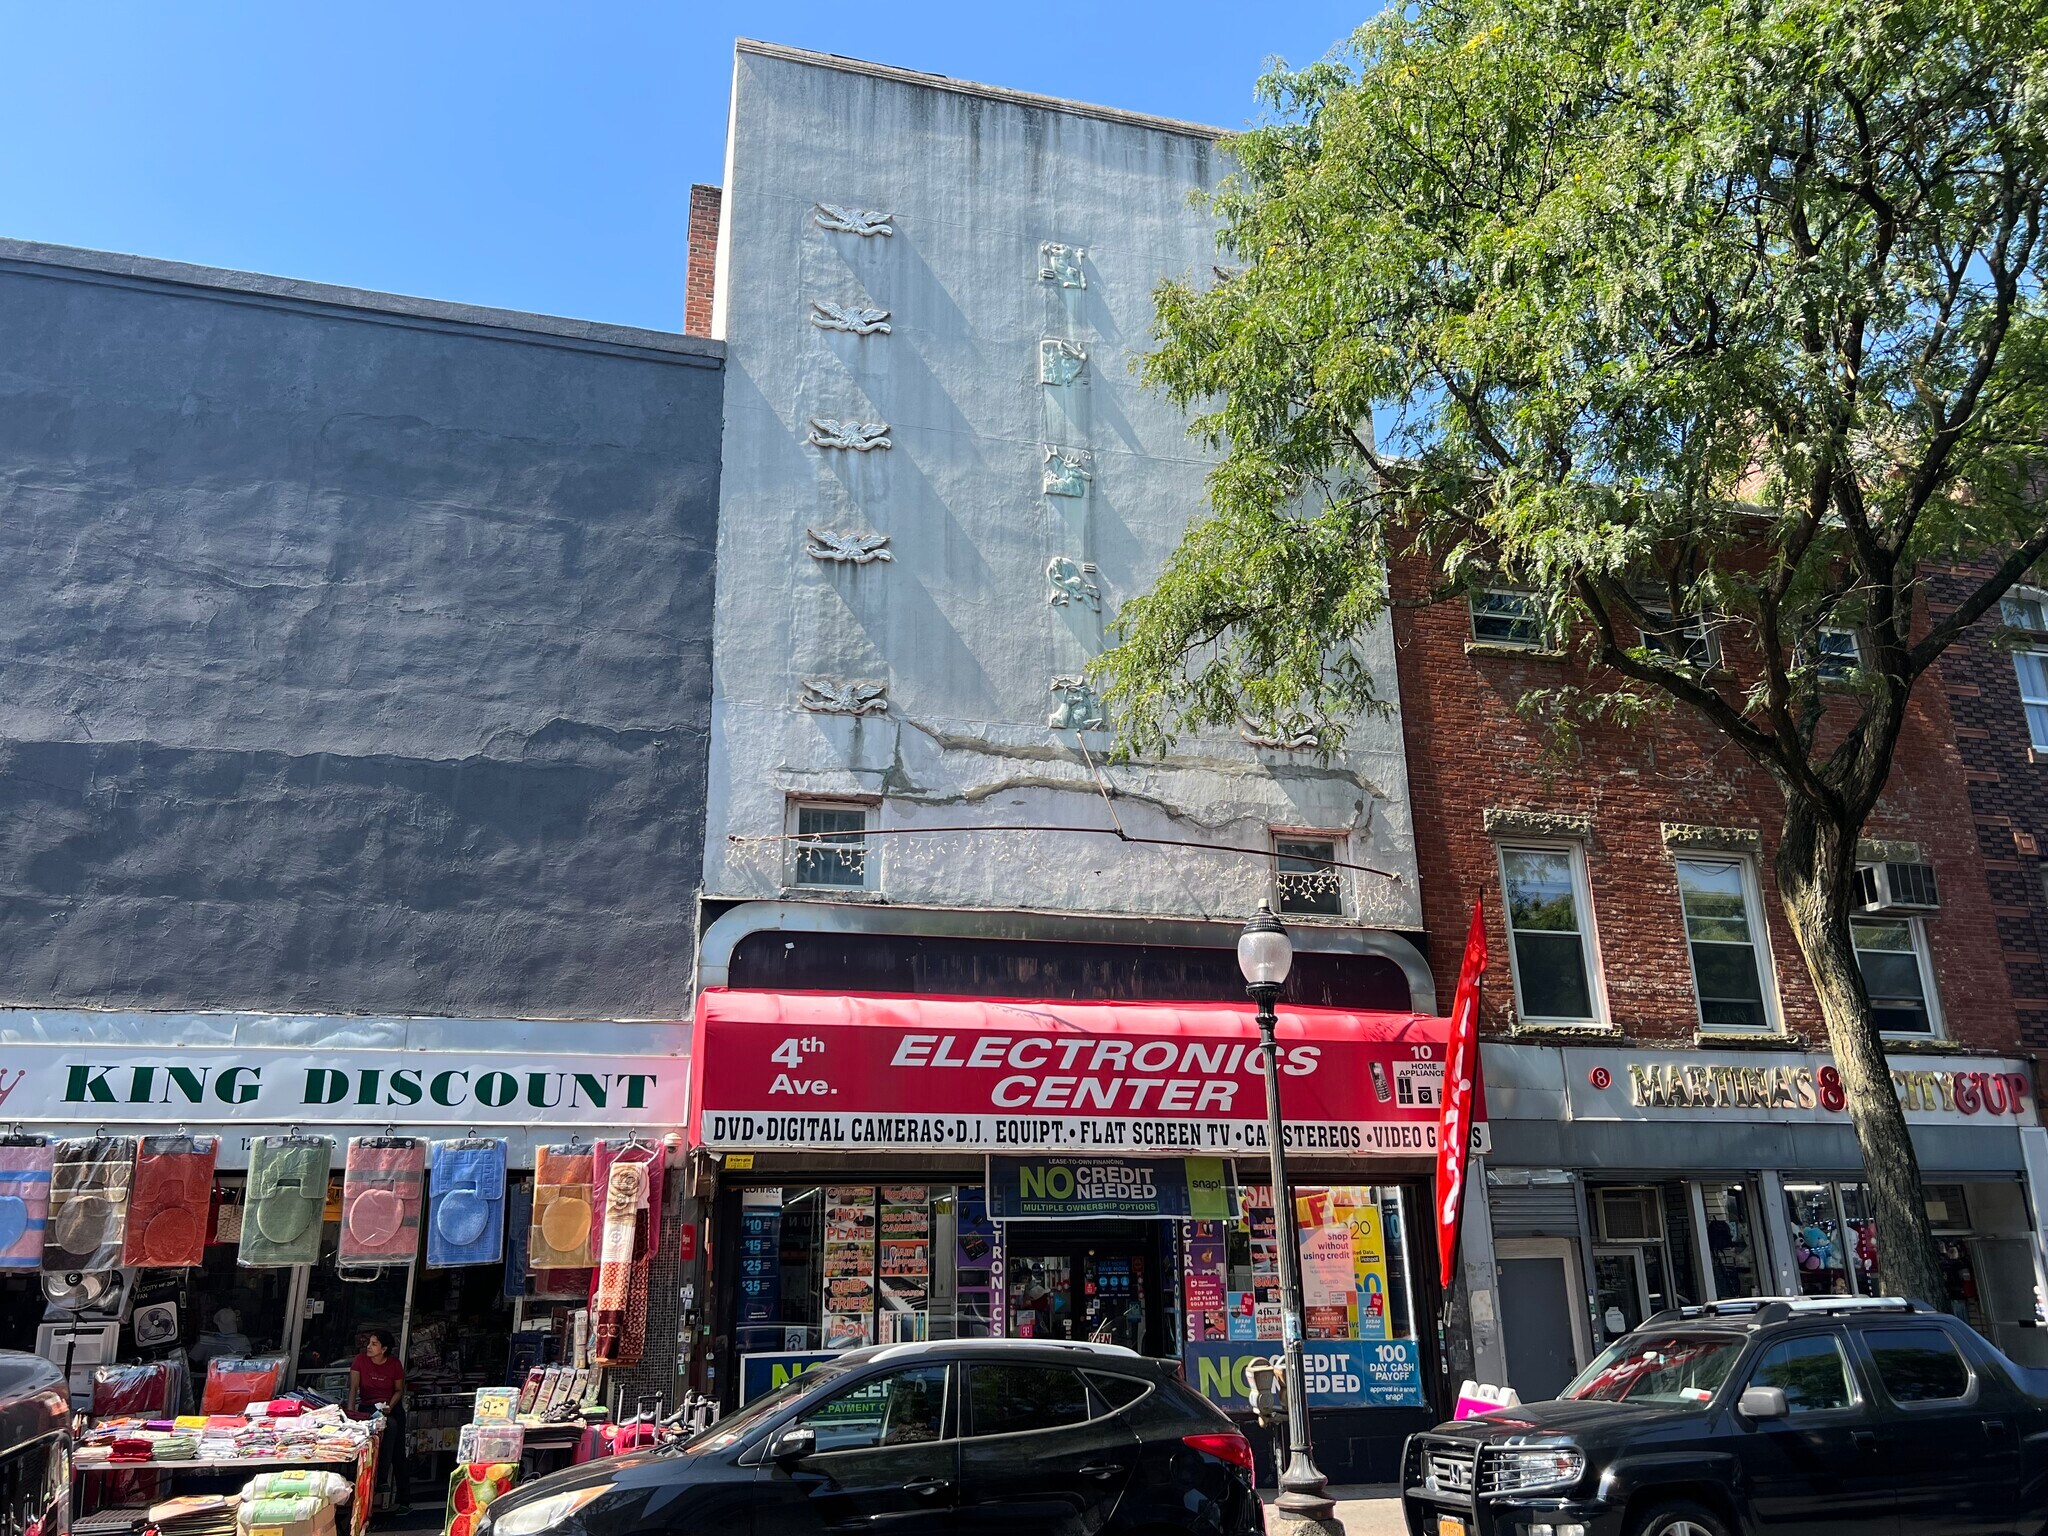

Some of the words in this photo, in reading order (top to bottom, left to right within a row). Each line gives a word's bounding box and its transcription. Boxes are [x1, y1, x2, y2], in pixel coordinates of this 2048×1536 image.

[771, 1036, 825, 1069] 4th
[890, 1034, 1321, 1076] ELECTRONICS
[1410, 1045, 1433, 1060] 10
[60, 1064, 264, 1106] KING
[299, 1067, 657, 1110] DISCOUNT
[768, 1073, 838, 1096] Ave.
[990, 1075, 1239, 1112] CENTER
[714, 1116, 755, 1141] DVD
[766, 1117, 845, 1142] DIGITAL
[851, 1118, 945, 1143] CAMERAS
[956, 1120, 988, 1144] D.J.
[996, 1120, 1068, 1146] EQUIPT.
[1080, 1121, 1127, 1145] FLAT
[1133, 1121, 1201, 1146] SCREEN
[1207, 1123, 1231, 1146] TV
[1245, 1123, 1271, 1147] CA
[1283, 1124, 1361, 1148] STEREOS
[1372, 1126, 1421, 1148] VIDEO
[1076, 1166, 1154, 1184] CREDIT
[1019, 1166, 1075, 1199] NO
[1192, 1179, 1221, 1192] snap!
[884, 1189, 925, 1200] REPAIRS
[1076, 1183, 1157, 1200] NEEDED
[1066, 1203, 1117, 1211] OWNERSHIP
[1119, 1202, 1156, 1211] OPTIONS
[835, 1208, 866, 1222] HOT
[826, 1227, 874, 1240] PLATE
[1327, 1233, 1348, 1242] Shop
[1317, 1242, 1349, 1250] without
[1303, 1252, 1325, 1261] using
[1326, 1251, 1350, 1259] credit
[831, 1280, 868, 1293] DEEP
[829, 1297, 869, 1310] FRIER
[830, 1323, 868, 1337] IRON
[1374, 1344, 1407, 1362] 100
[1369, 1363, 1387, 1372] DAY
[1389, 1363, 1415, 1372] CASH
[1375, 1371, 1410, 1381] PAYOFF
[828, 1403, 876, 1413] PAYMENT
